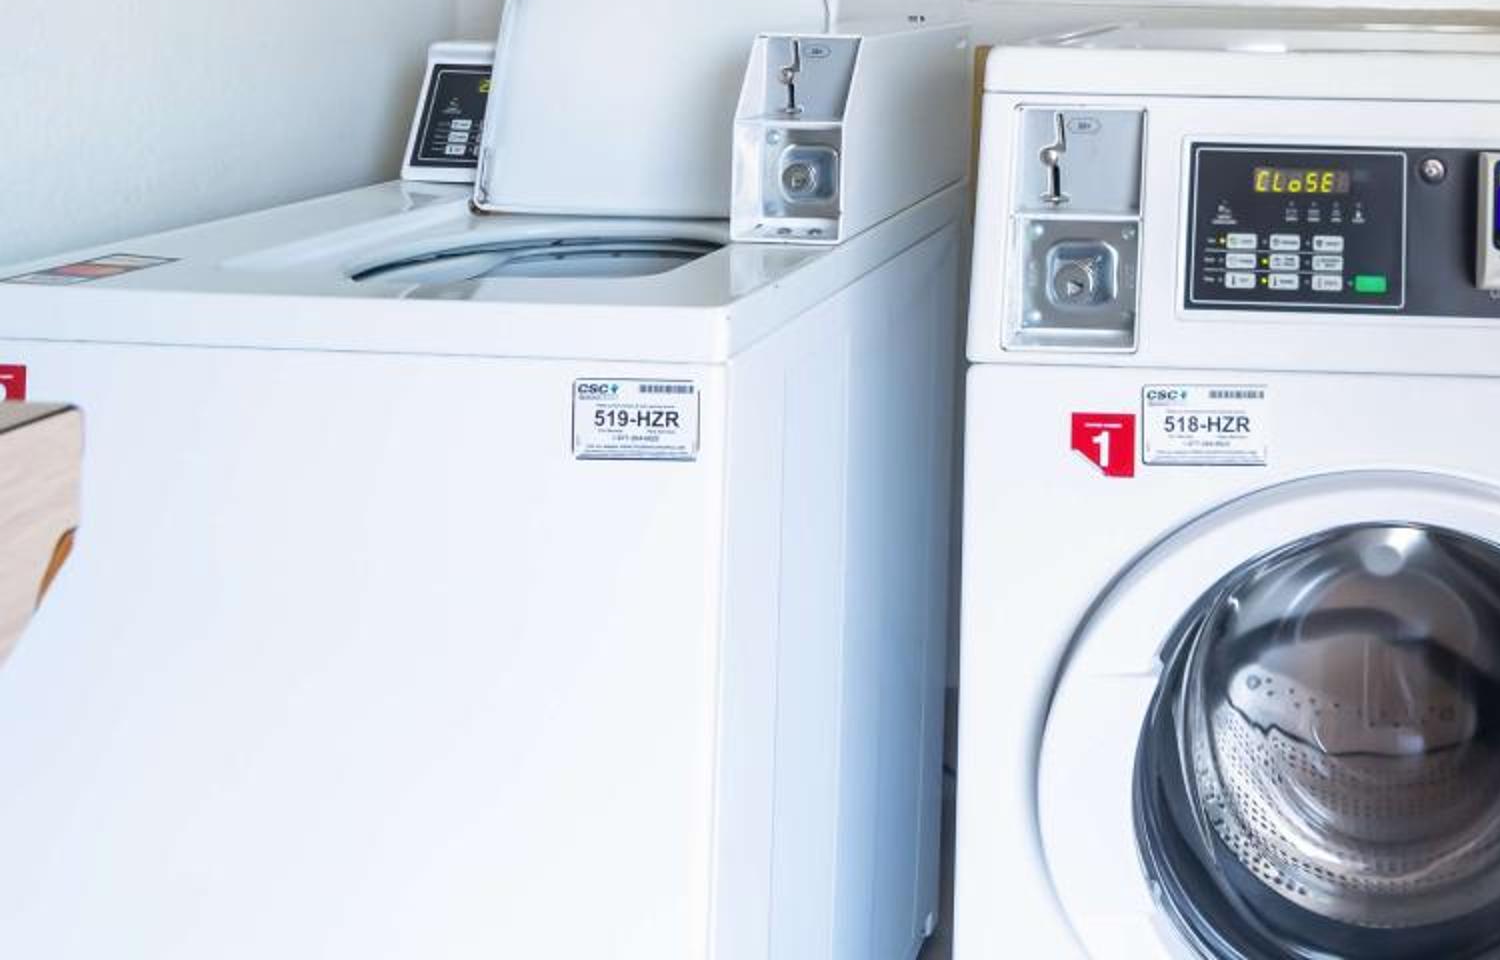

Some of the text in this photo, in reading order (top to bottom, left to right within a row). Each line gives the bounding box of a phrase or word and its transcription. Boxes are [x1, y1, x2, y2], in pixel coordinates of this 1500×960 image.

[577, 383, 609, 394] CSC
[1146, 390, 1178, 401] CSC
[593, 409, 680, 428] 519-HZR
[1163, 415, 1251, 434] 518-HZR
[1092, 430, 1110, 468] 1
